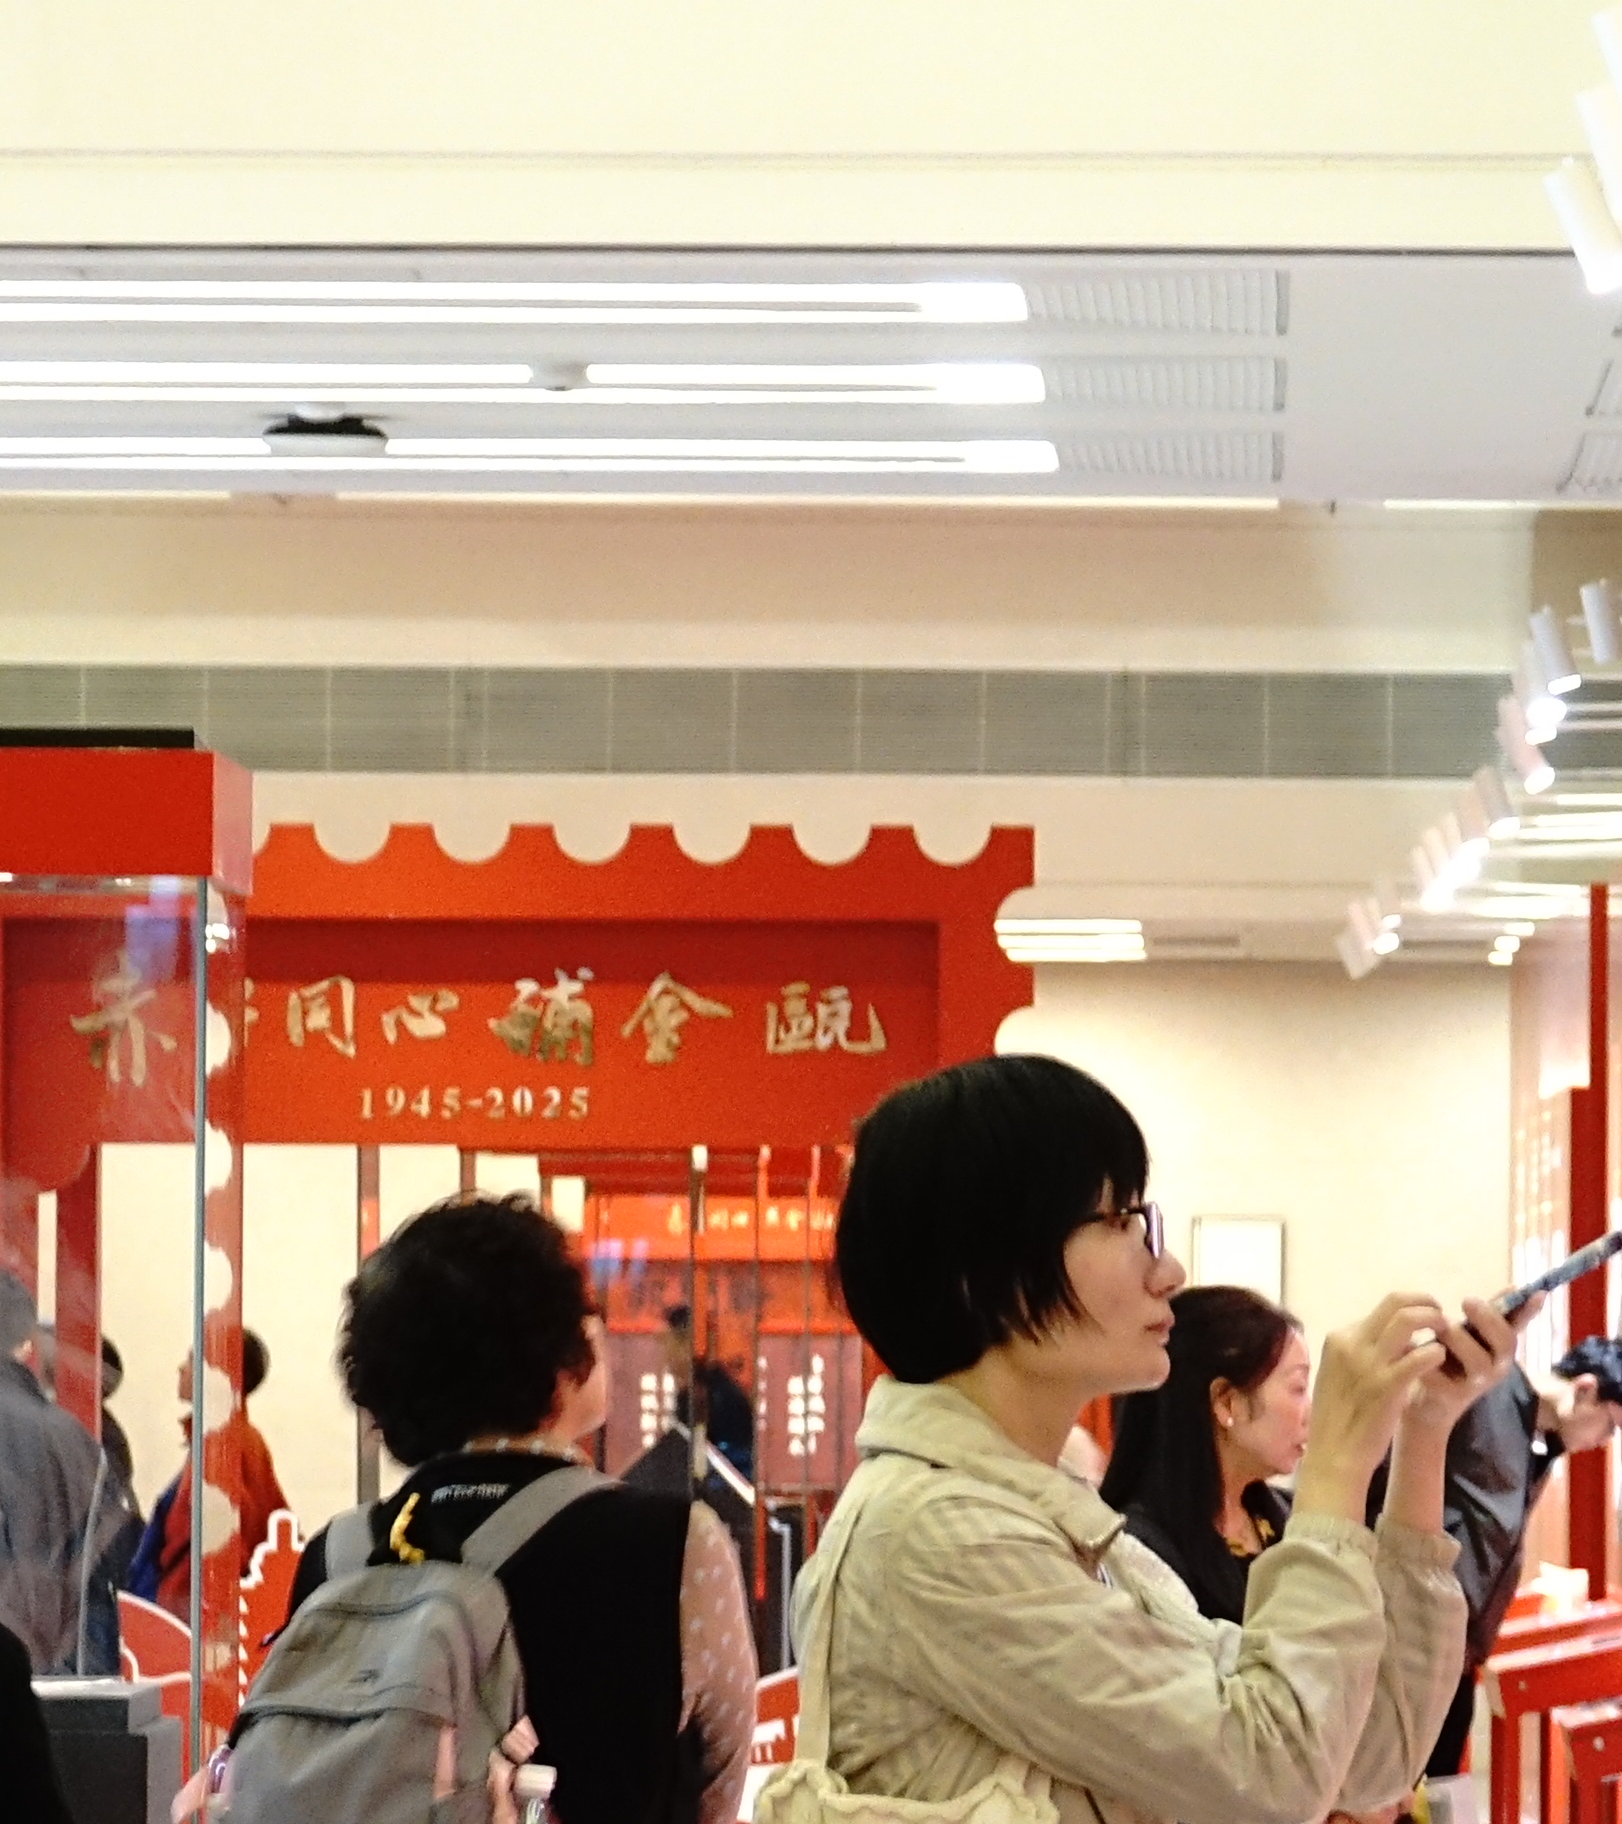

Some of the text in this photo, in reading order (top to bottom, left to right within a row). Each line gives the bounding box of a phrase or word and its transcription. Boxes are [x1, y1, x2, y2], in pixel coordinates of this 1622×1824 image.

[70, 950, 887, 1087] 赤同心補金甌
[358, 1086, 590, 1120] 1945-2025
